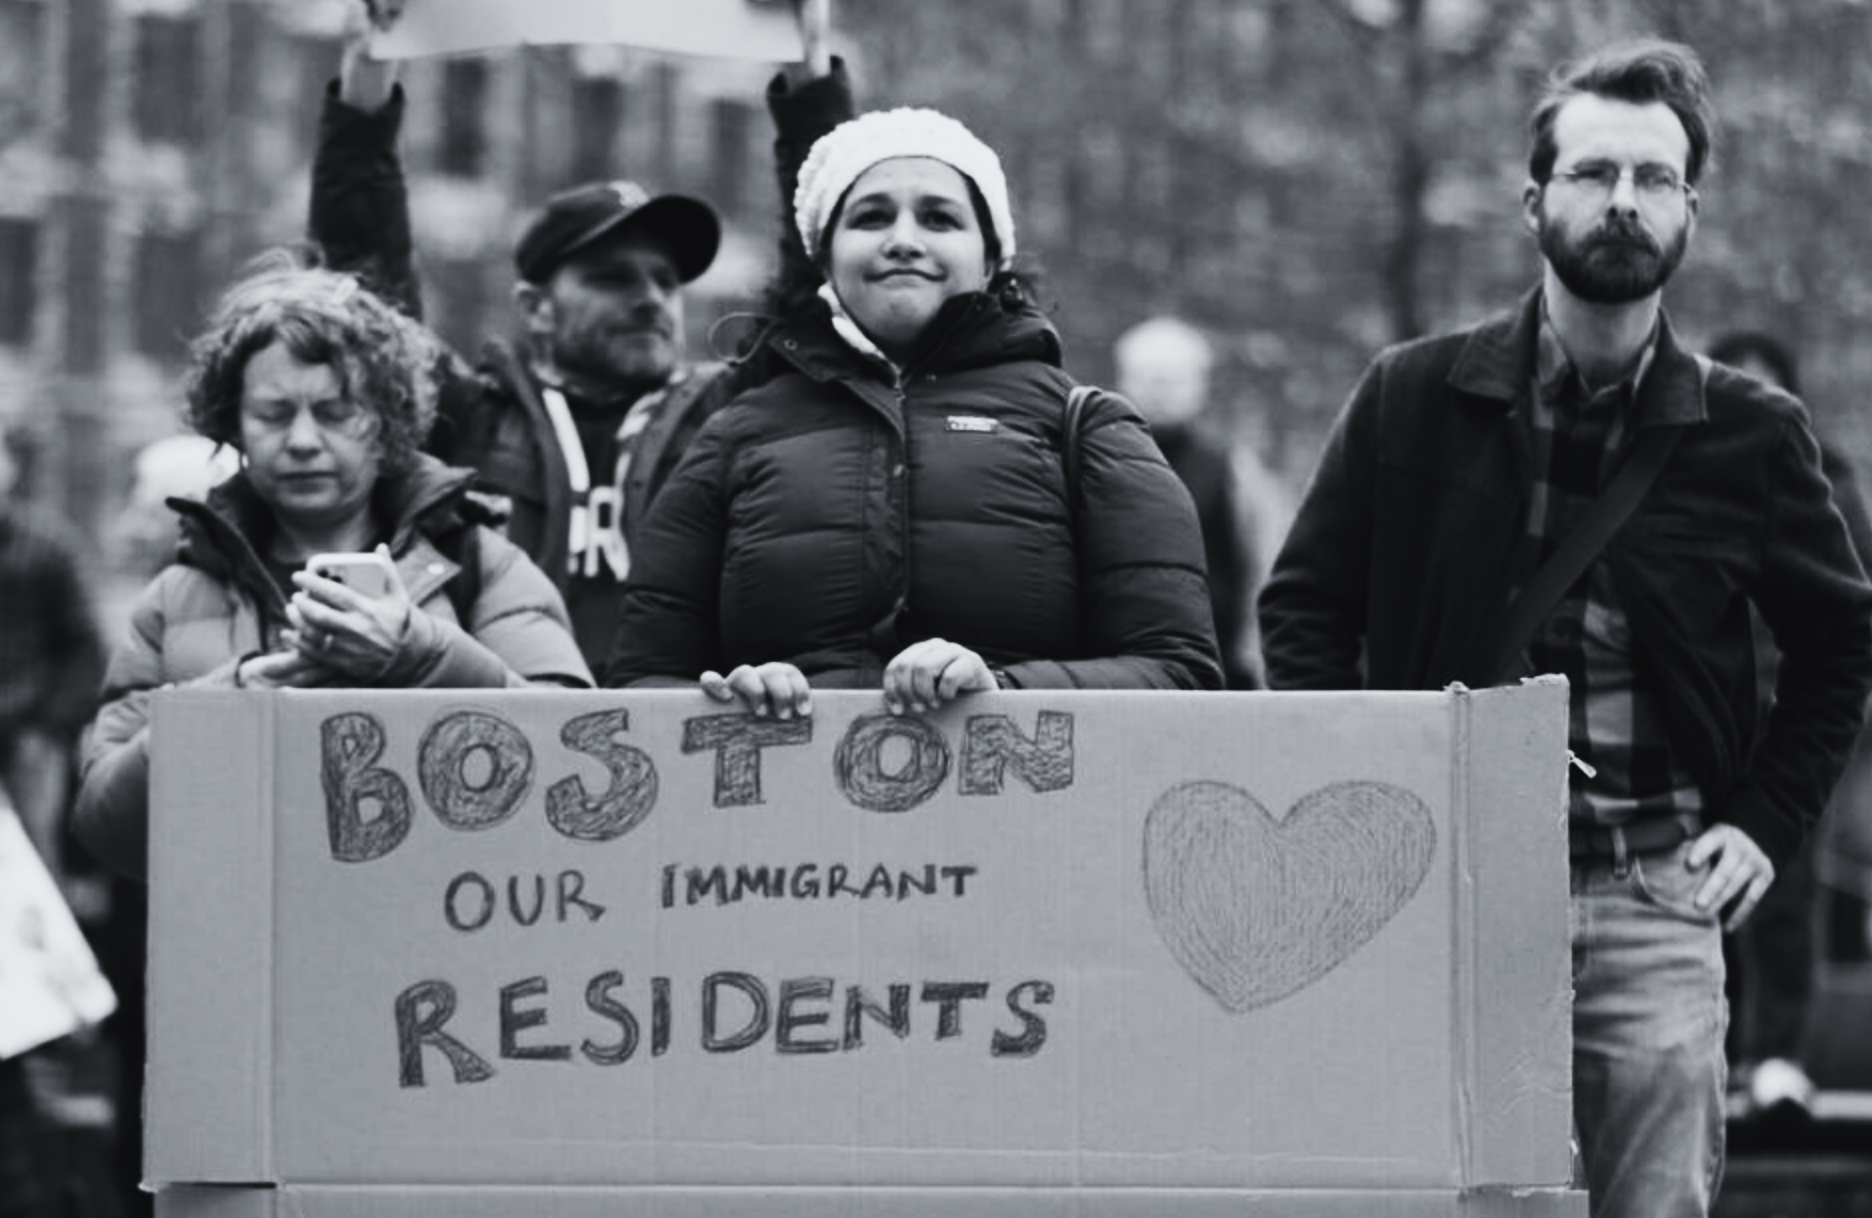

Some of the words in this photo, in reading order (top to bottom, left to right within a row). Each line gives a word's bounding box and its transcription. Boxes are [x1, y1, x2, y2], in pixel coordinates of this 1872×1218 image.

[319, 708, 1076, 863] BOSTON
[443, 869, 606, 932] OUR
[660, 861, 978, 910] IMMIGRANT
[394, 969, 1056, 1089] RESIDENTS
